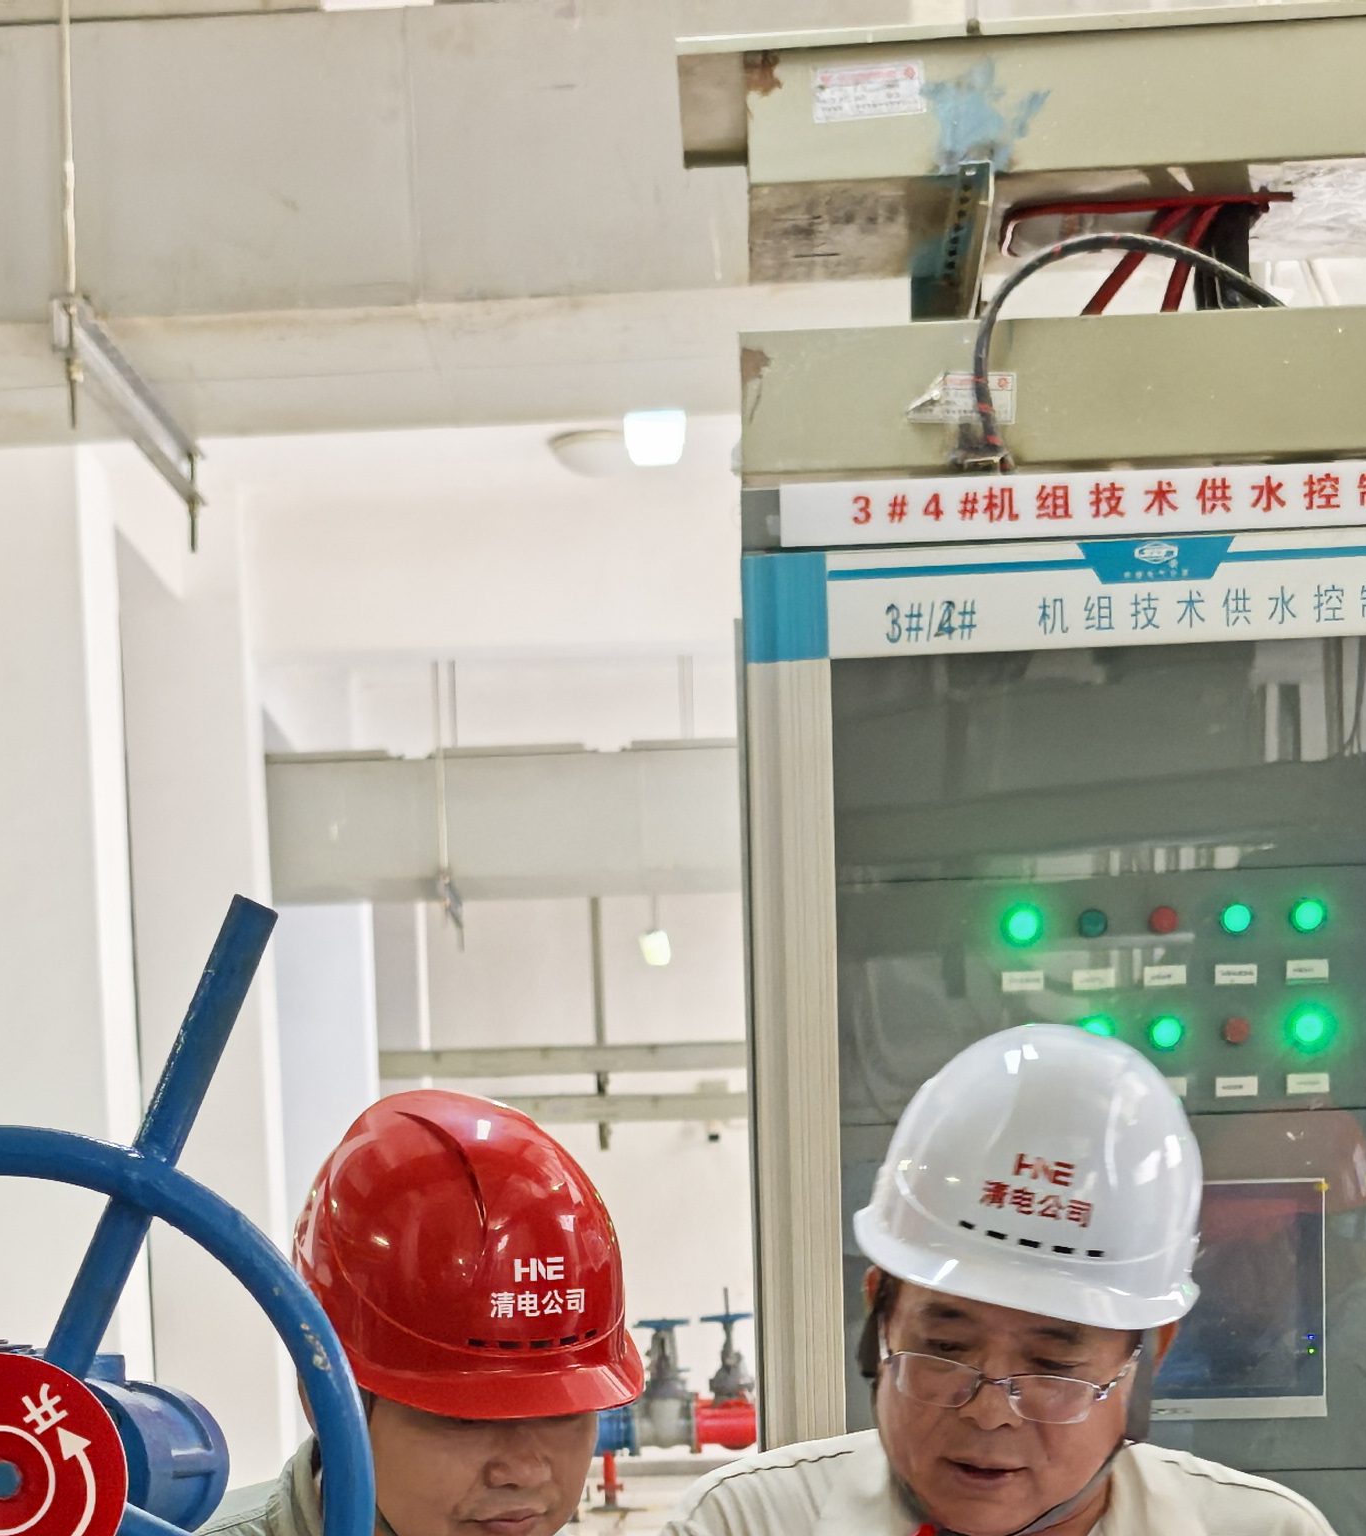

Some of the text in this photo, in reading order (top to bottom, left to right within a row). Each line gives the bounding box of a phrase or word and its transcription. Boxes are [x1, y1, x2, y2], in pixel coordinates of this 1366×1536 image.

[979, 1179, 1095, 1228] 清电公司
[490, 1288, 586, 1319] 清电公司
[21, 1383, 69, 1435] 开
